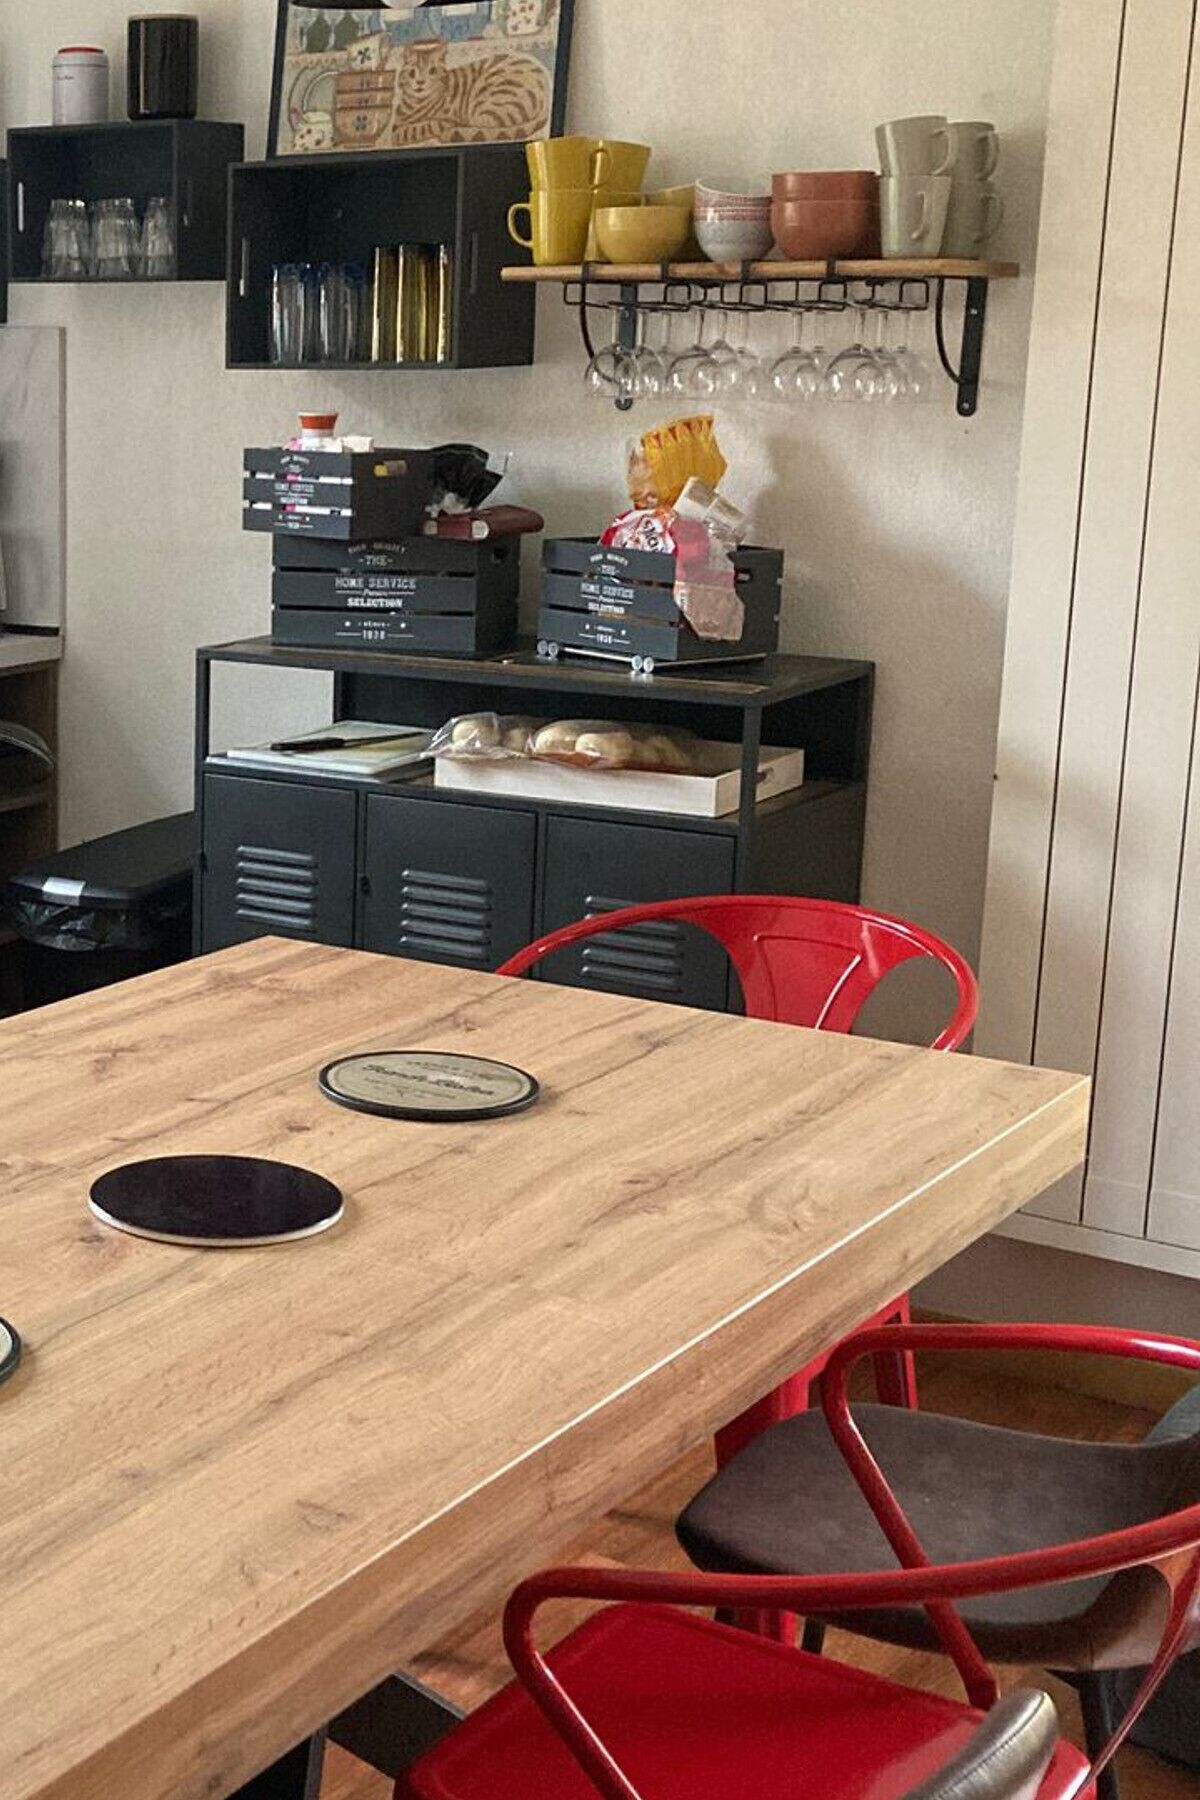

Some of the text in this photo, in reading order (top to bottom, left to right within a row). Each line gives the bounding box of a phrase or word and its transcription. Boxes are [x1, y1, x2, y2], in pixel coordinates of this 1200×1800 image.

[335, 577, 417, 590] HOME SERVICE
[347, 597, 403, 608] SELECTION
